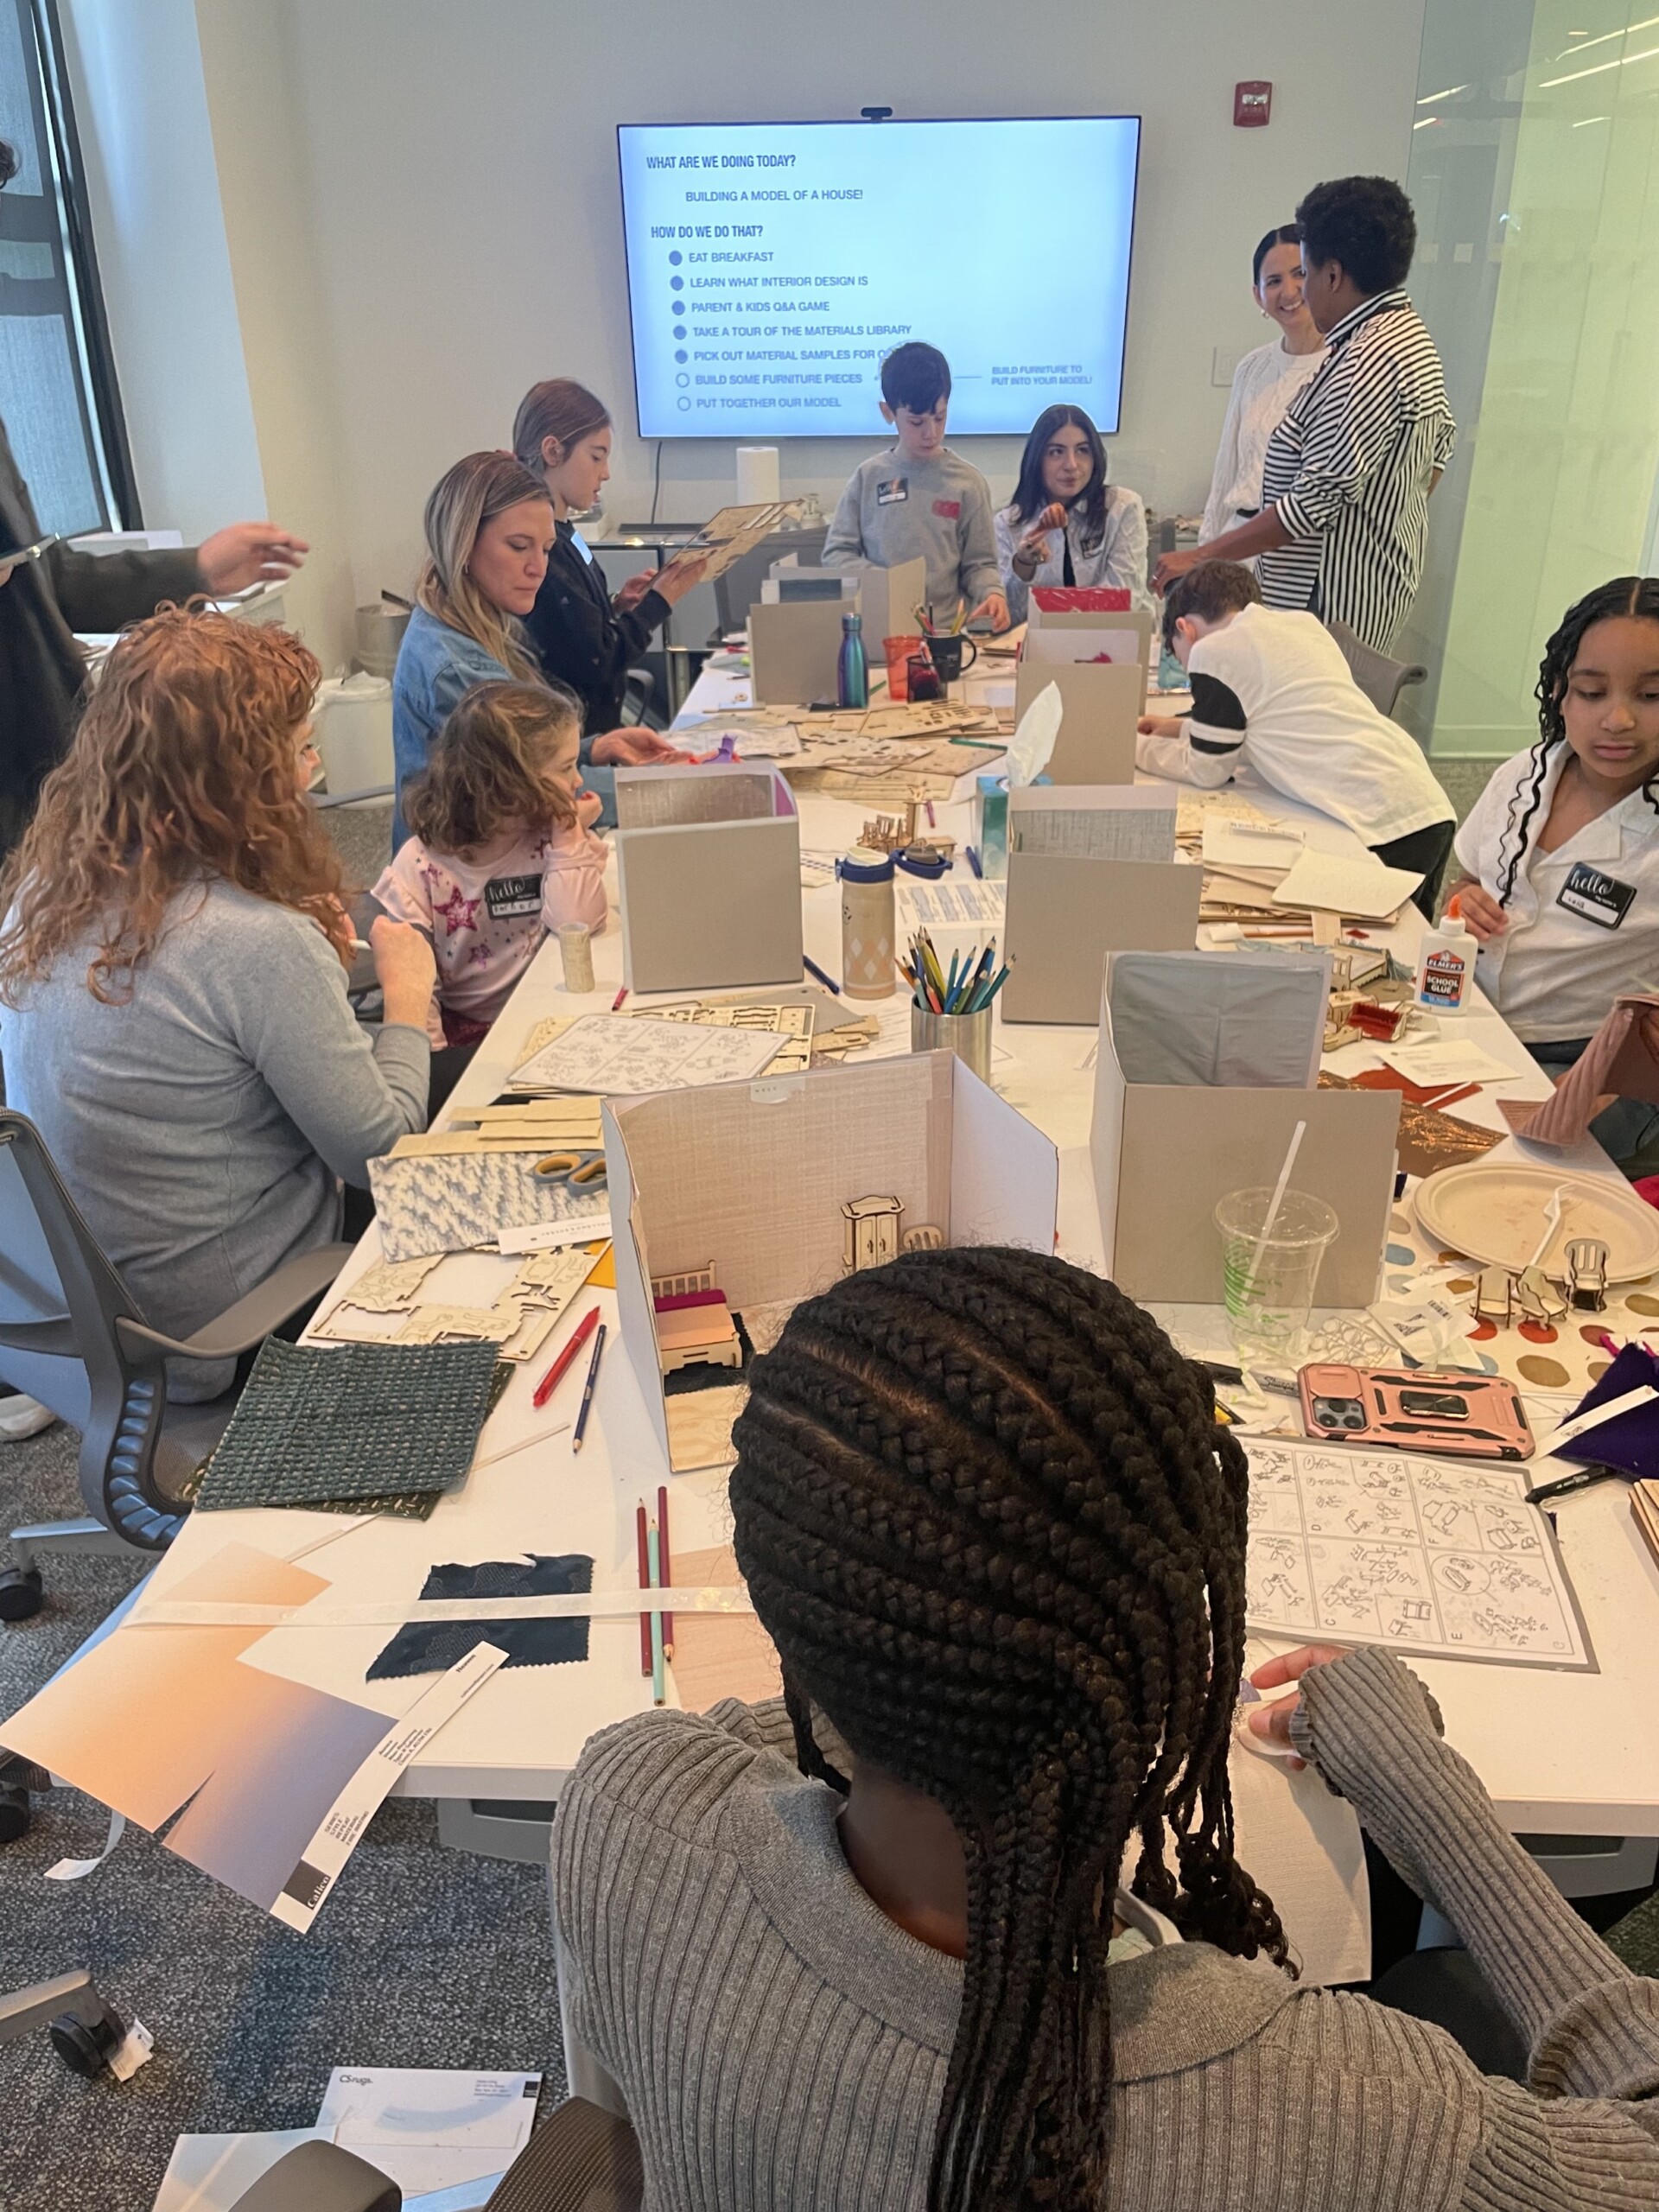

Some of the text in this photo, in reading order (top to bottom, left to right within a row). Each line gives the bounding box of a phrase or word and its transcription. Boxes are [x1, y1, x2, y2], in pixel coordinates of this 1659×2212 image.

[646, 154, 797, 168] WHAT ARE WE DOING TODAY?
[685, 189, 863, 202] BUILDING A MODEL OF A HOUSE!
[651, 225, 764, 238] HOW DO WE DO THAT?
[689, 251, 774, 263] EAT BREAKFAST
[690, 276, 868, 288] LEARN WHAT INTERIOR DESIGN IS
[691, 301, 830, 313] PARENT & KIDS Q&A GAME
[693, 325, 912, 337] TAKE A TOUR OF THE MATERIALS LIBRARY
[694, 351, 719, 361] PICK
[721, 351, 743, 361] OUT
[746, 350, 798, 360] MATERIAL
[800, 350, 850, 360] SAMPLES
[853, 349, 875, 359] FOR
[992, 365, 1082, 375] BUILD FURNITURE TO
[695, 373, 862, 385] BUILD SOME FURNITURE PIECES
[696, 397, 842, 409] PUT TOGETHER OUR MODEL
[1570, 868, 1615, 895] hello
[489, 876, 525, 902] hello
[1427, 976, 1459, 987] SCHOOL
[1431, 984, 1452, 994] GLUE
[456, 1654, 477, 1673] Heaven
[307, 1876, 331, 1910] Calico
